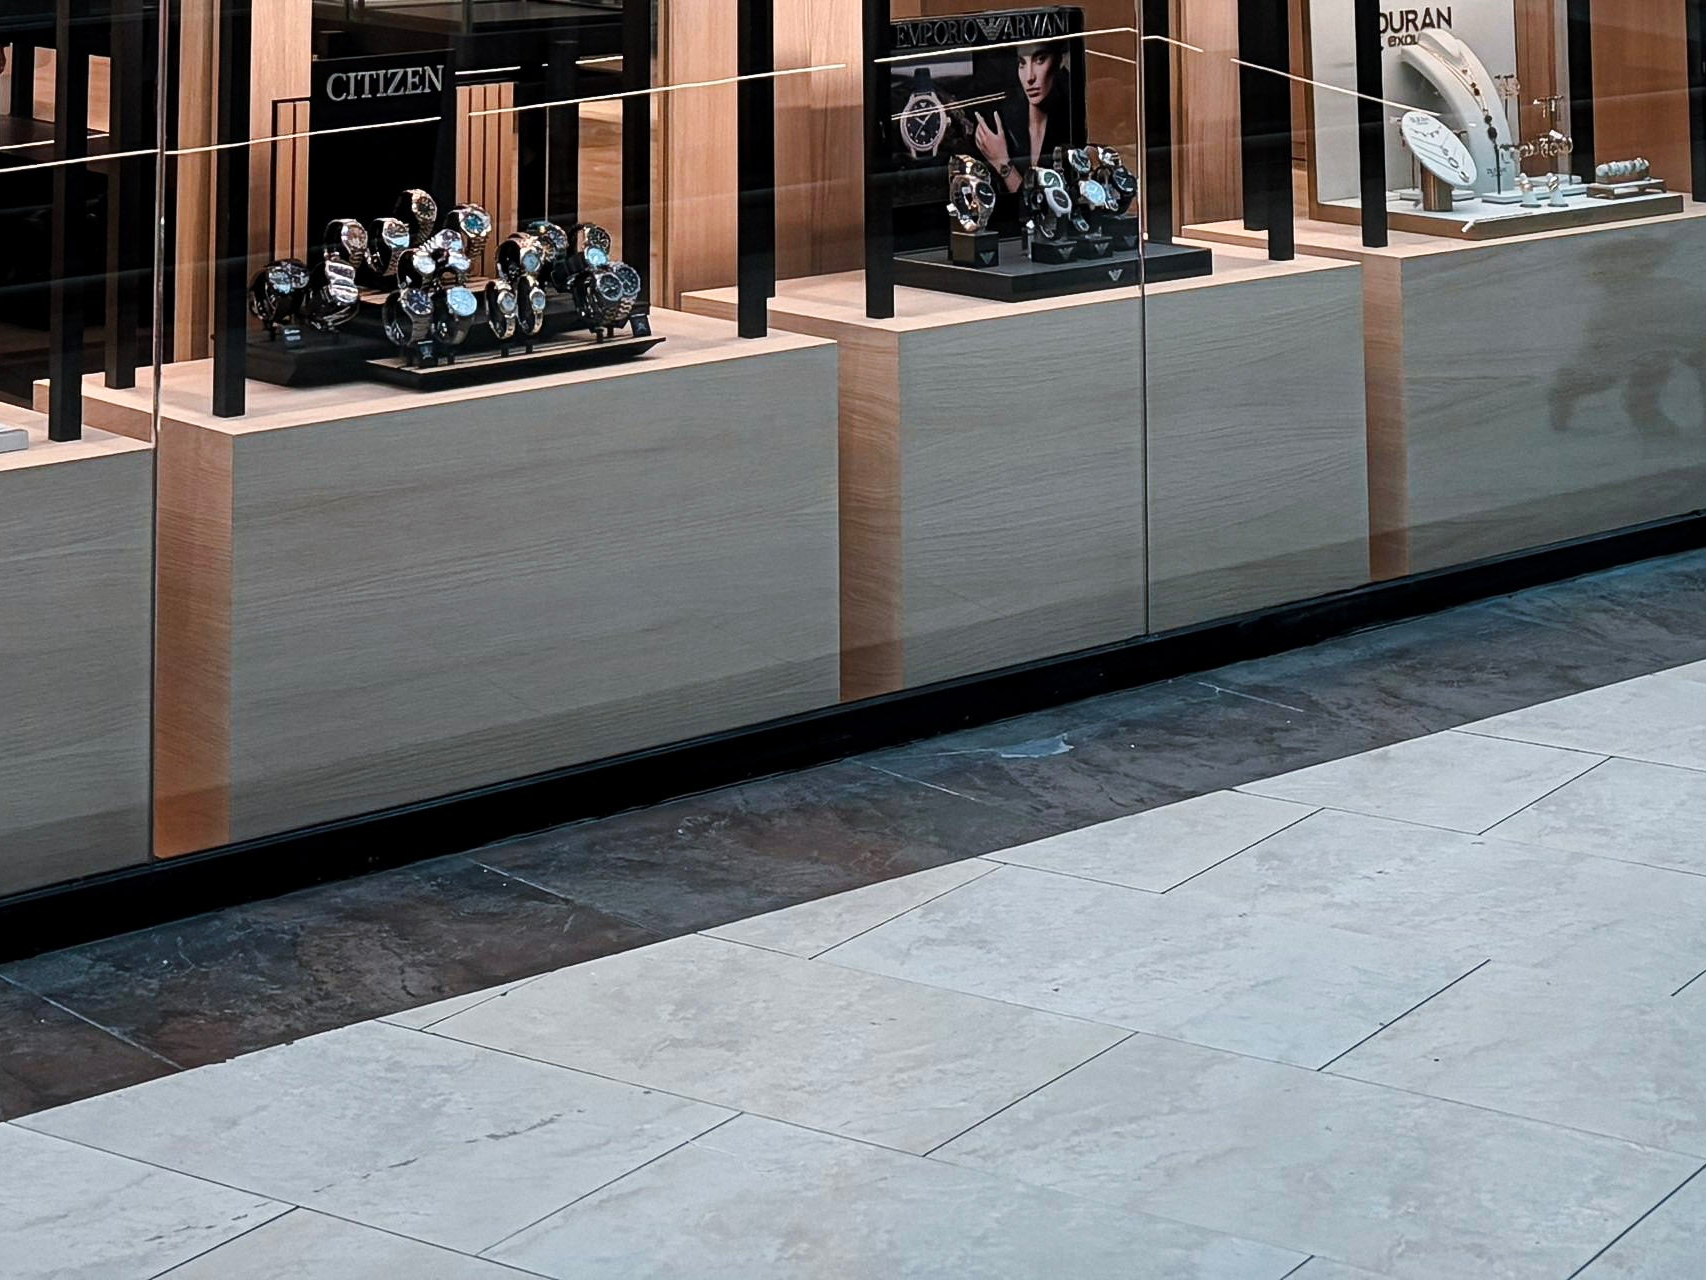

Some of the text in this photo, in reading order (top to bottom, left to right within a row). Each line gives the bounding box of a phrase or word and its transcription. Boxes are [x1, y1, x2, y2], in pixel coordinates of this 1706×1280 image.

[895, 13, 1070, 49] EMPORIO ARMANI
[326, 64, 445, 102] CITIZEN
